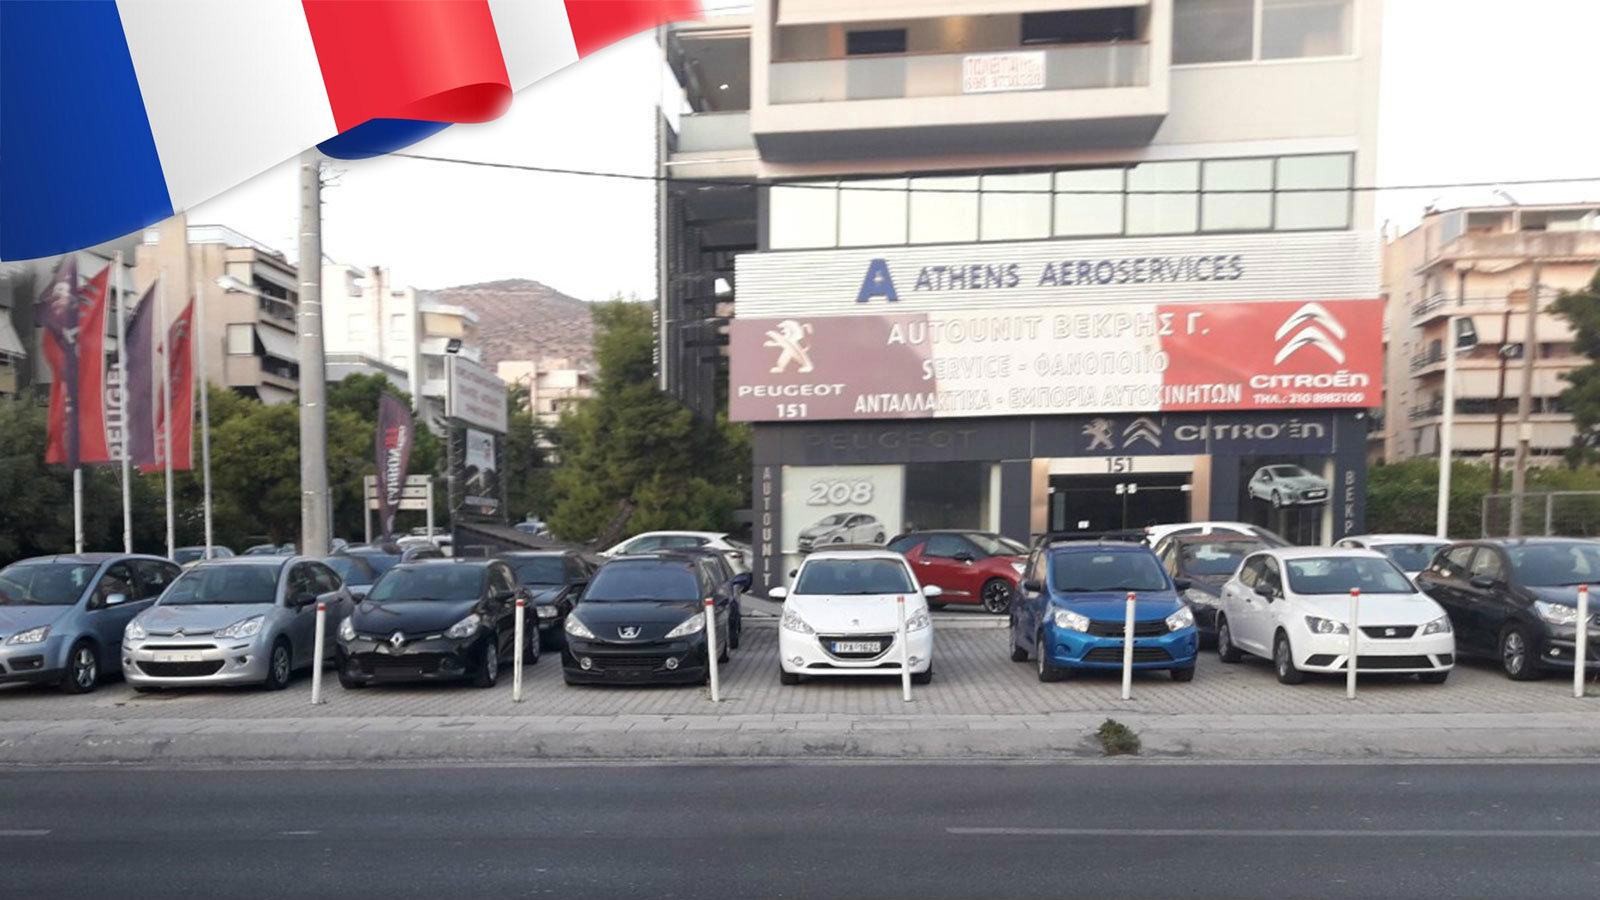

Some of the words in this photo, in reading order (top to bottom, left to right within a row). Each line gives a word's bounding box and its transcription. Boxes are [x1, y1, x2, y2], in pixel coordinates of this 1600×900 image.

[913, 263, 1020, 291] ATHENS
[1038, 255, 1245, 287] AEROSERVICES
[888, 315, 1041, 345] AUTOUNIT
[1053, 312, 1175, 340] ΒΕΚΡΗΣ
[922, 354, 1011, 380] SERVICE
[738, 383, 846, 398] PEUGEOT
[776, 403, 807, 418] 151
[804, 429, 977, 450] PEUGEOT
[1105, 457, 1133, 473] 151
[806, 480, 874, 506] 208
